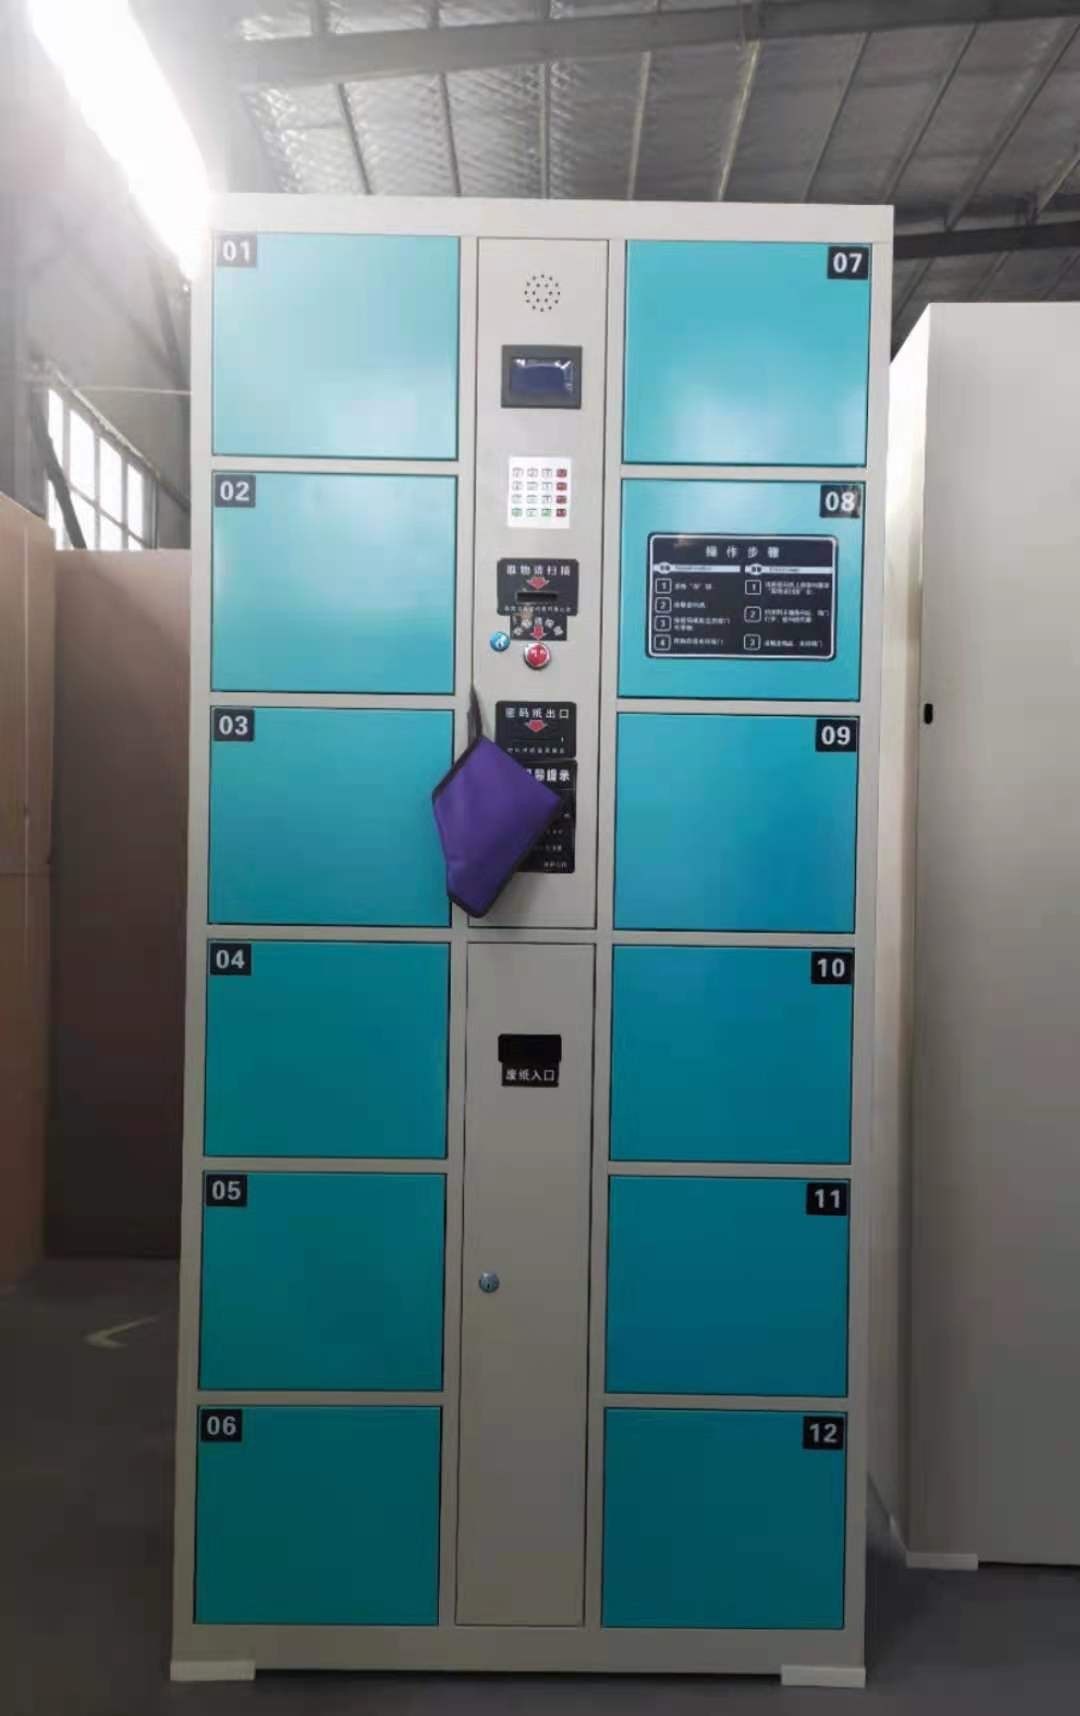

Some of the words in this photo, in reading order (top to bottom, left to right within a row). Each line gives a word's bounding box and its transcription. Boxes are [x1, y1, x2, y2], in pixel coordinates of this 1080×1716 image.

[222, 240, 250, 262] 01
[833, 252, 863, 273] 07
[220, 480, 250, 501] 02
[825, 491, 857, 512] 08
[706, 545, 779, 559] 操作步骤
[505, 707, 569, 719] 密码纸出口
[218, 715, 248, 736] 03
[821, 725, 851, 746] 09
[215, 949, 245, 969] 04
[817, 958, 845, 978] 10
[505, 1069, 555, 1081] 废纸入口
[212, 1180, 241, 1201] 05
[815, 1189, 840, 1209] 11
[206, 1415, 237, 1436] 06
[810, 1423, 838, 1443] 12
